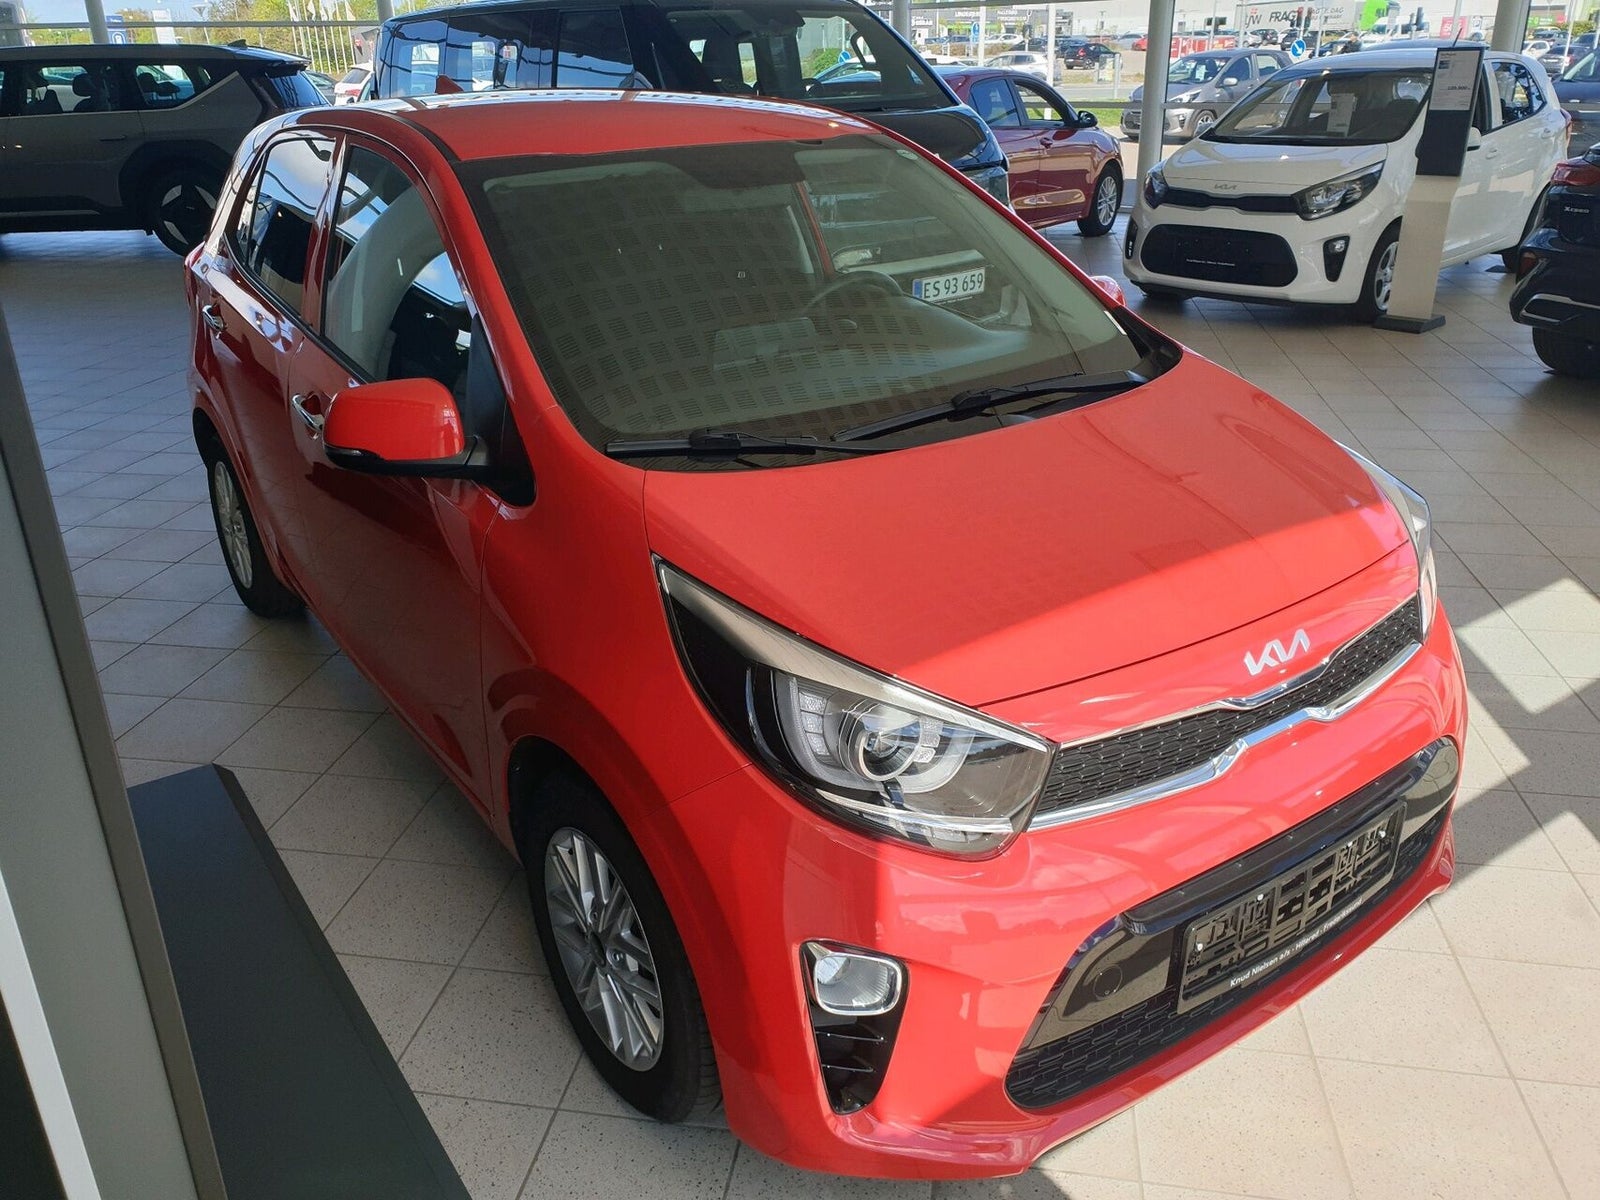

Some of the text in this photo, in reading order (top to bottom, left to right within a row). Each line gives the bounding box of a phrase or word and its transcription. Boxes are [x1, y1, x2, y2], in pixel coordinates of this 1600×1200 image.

[924, 272, 983, 299] ES 93 659
[1243, 628, 1311, 677] KIA
[1229, 971, 1251, 987] Knud
[1251, 956, 1279, 976] Nielsen
